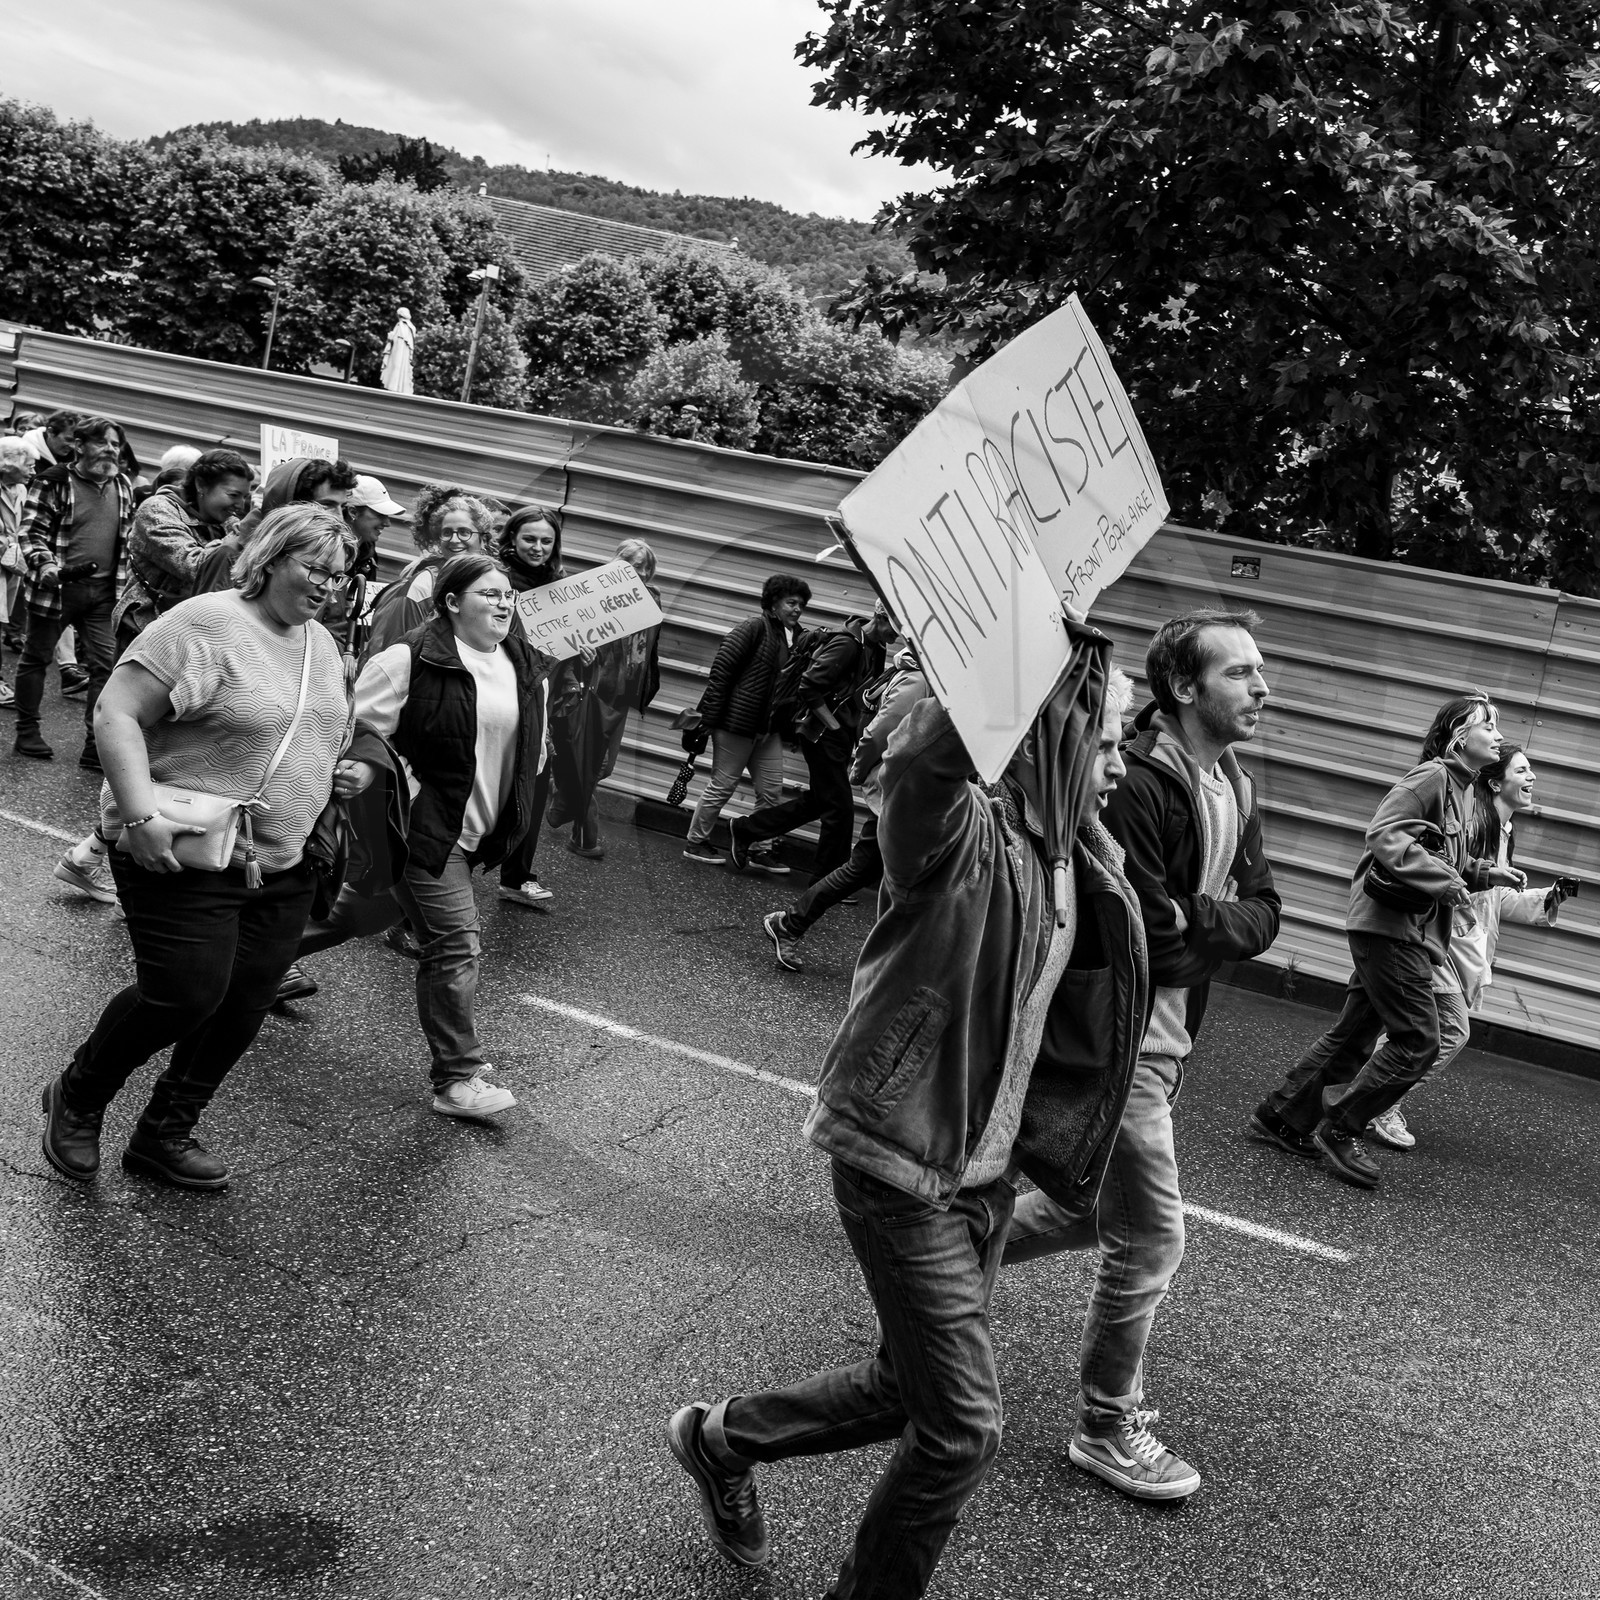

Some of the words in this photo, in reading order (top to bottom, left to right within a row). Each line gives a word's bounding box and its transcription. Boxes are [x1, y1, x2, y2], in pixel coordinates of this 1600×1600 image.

[271, 429, 287, 453] LA
[548, 580, 594, 605] AUCUNE
[597, 565, 638, 589] ENVIE
[1065, 538, 1104, 596] FRONT
[526, 614, 573, 643] METTRE
[576, 606, 597, 622] AU
